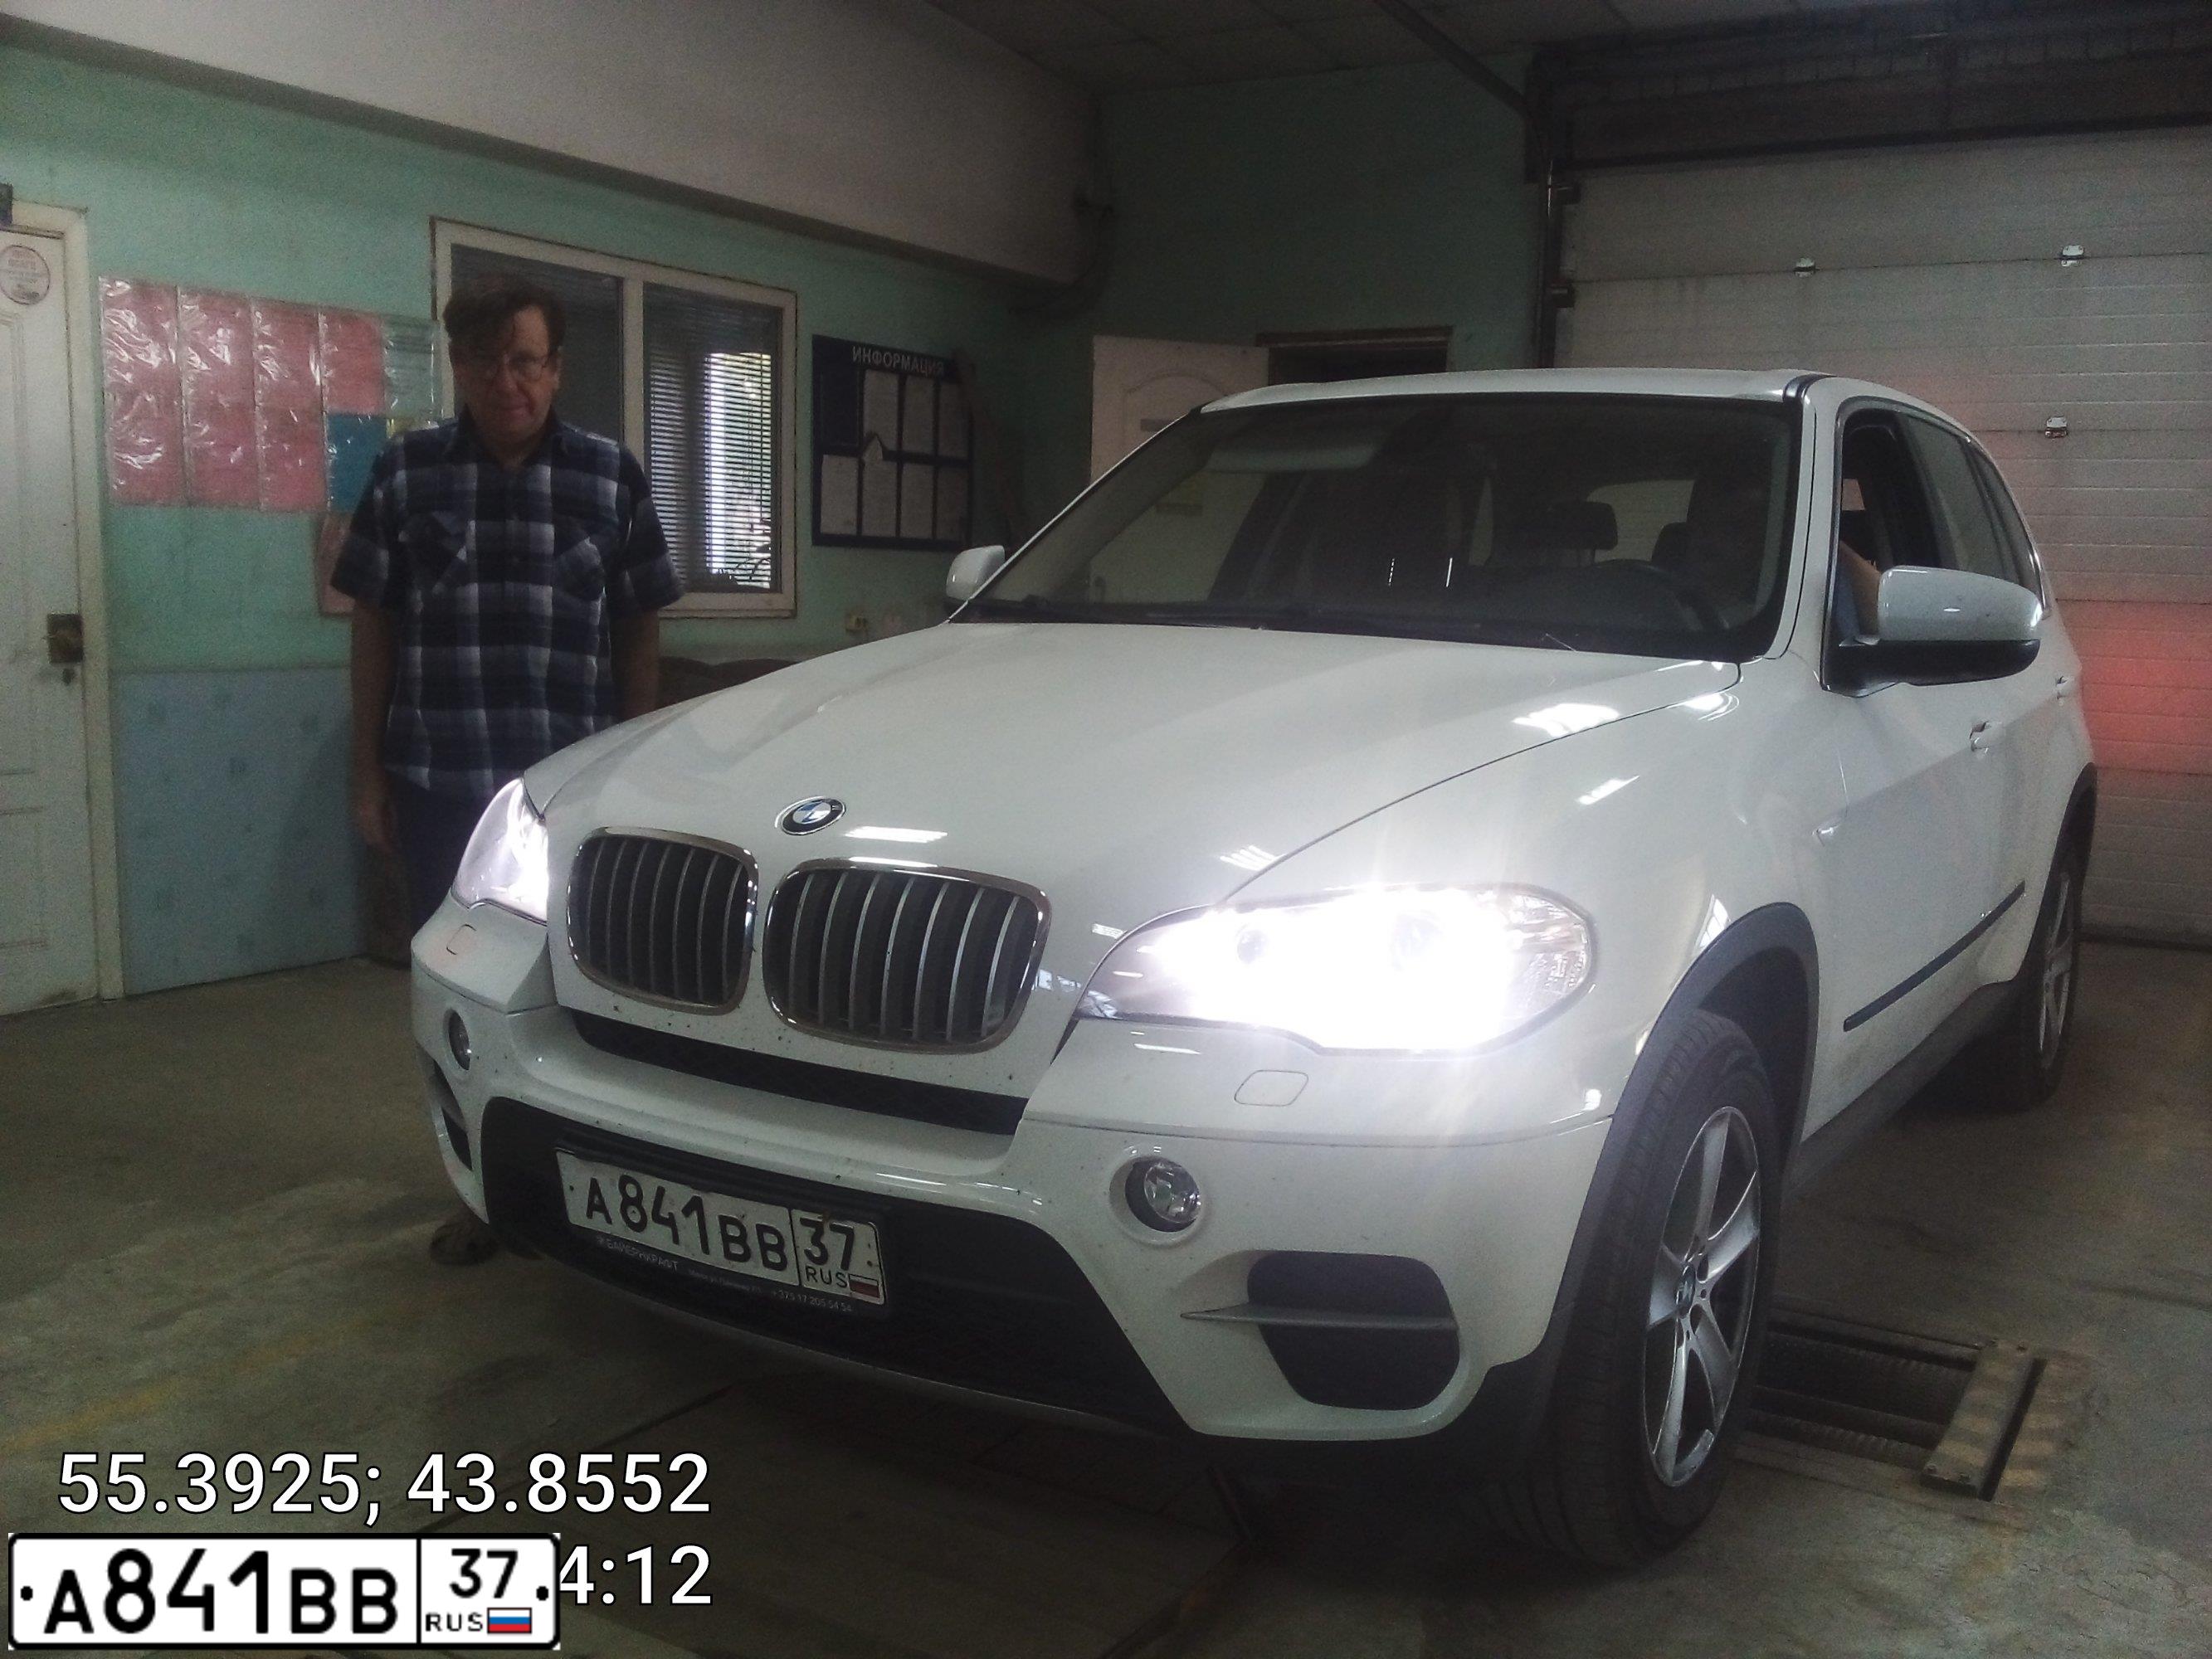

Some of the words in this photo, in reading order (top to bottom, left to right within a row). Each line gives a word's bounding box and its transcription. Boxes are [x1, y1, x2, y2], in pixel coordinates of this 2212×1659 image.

[852, 345, 944, 376] ИНФОРМАЦИЯ
[586, 1174, 788, 1272] А841ВВ
[799, 1217, 855, 1271] 37
[805, 1266, 849, 1289] RUS
